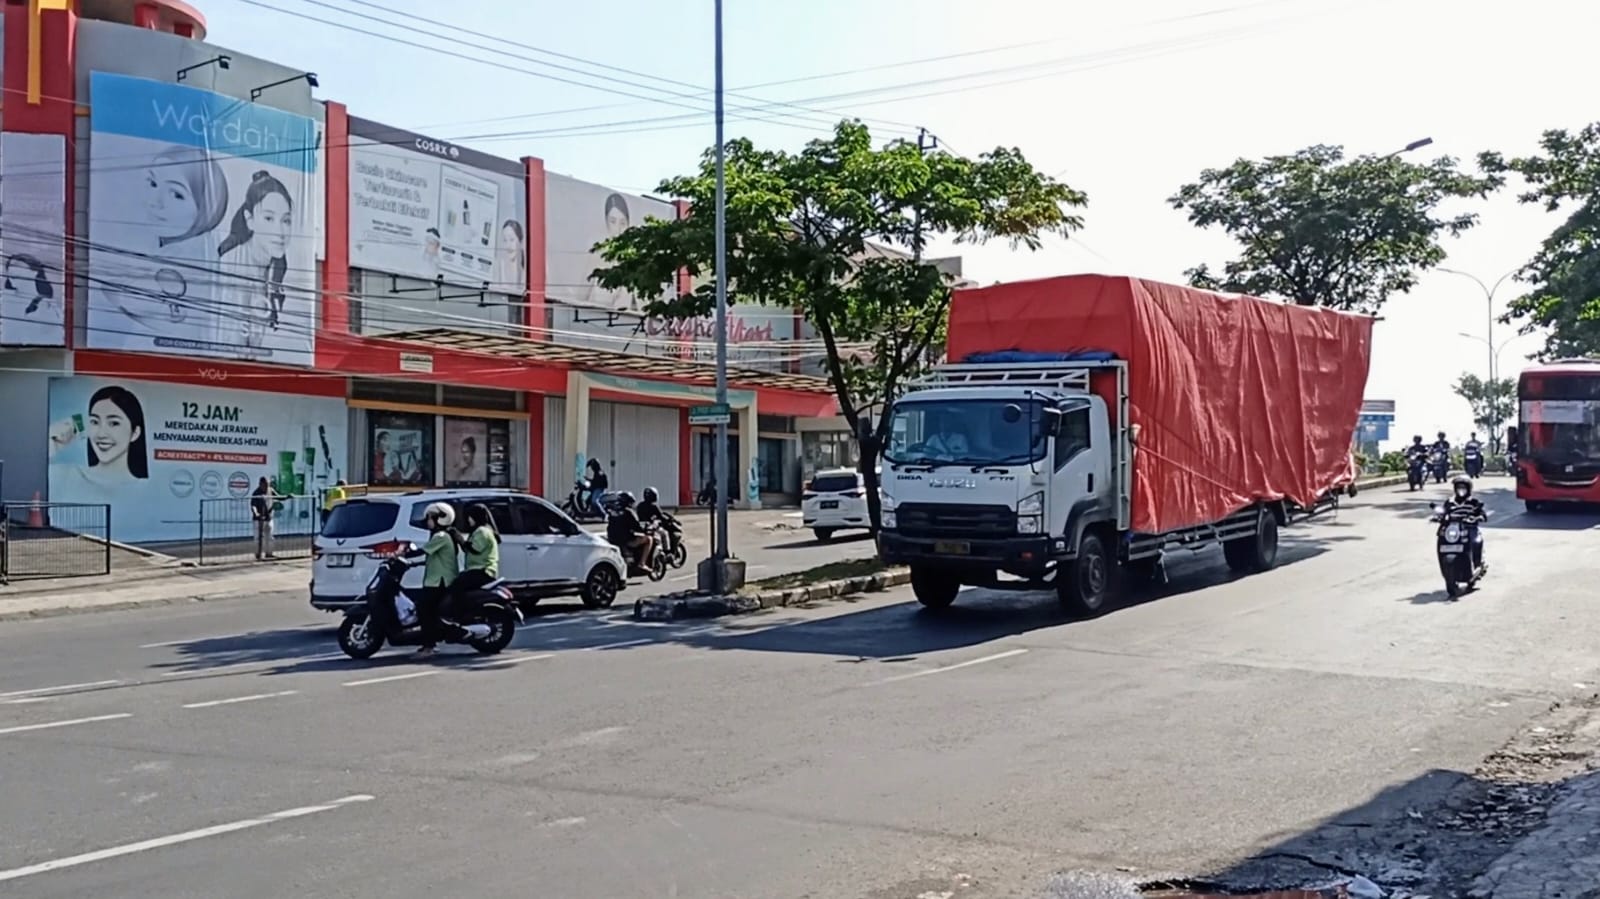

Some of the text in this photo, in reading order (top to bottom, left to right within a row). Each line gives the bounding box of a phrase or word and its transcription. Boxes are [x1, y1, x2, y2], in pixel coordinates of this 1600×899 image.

[152, 99, 279, 151] Wardah
[415, 138, 447, 155] COSRX
[198, 368, 227, 380] YOU
[182, 402, 198, 418] 12
[165, 421, 258, 434] MEREDAKAN JERAWAT
[153, 432, 268, 446] MENYAMARKAN BEKAS HITAM
[929, 478, 976, 488] ISUZU
